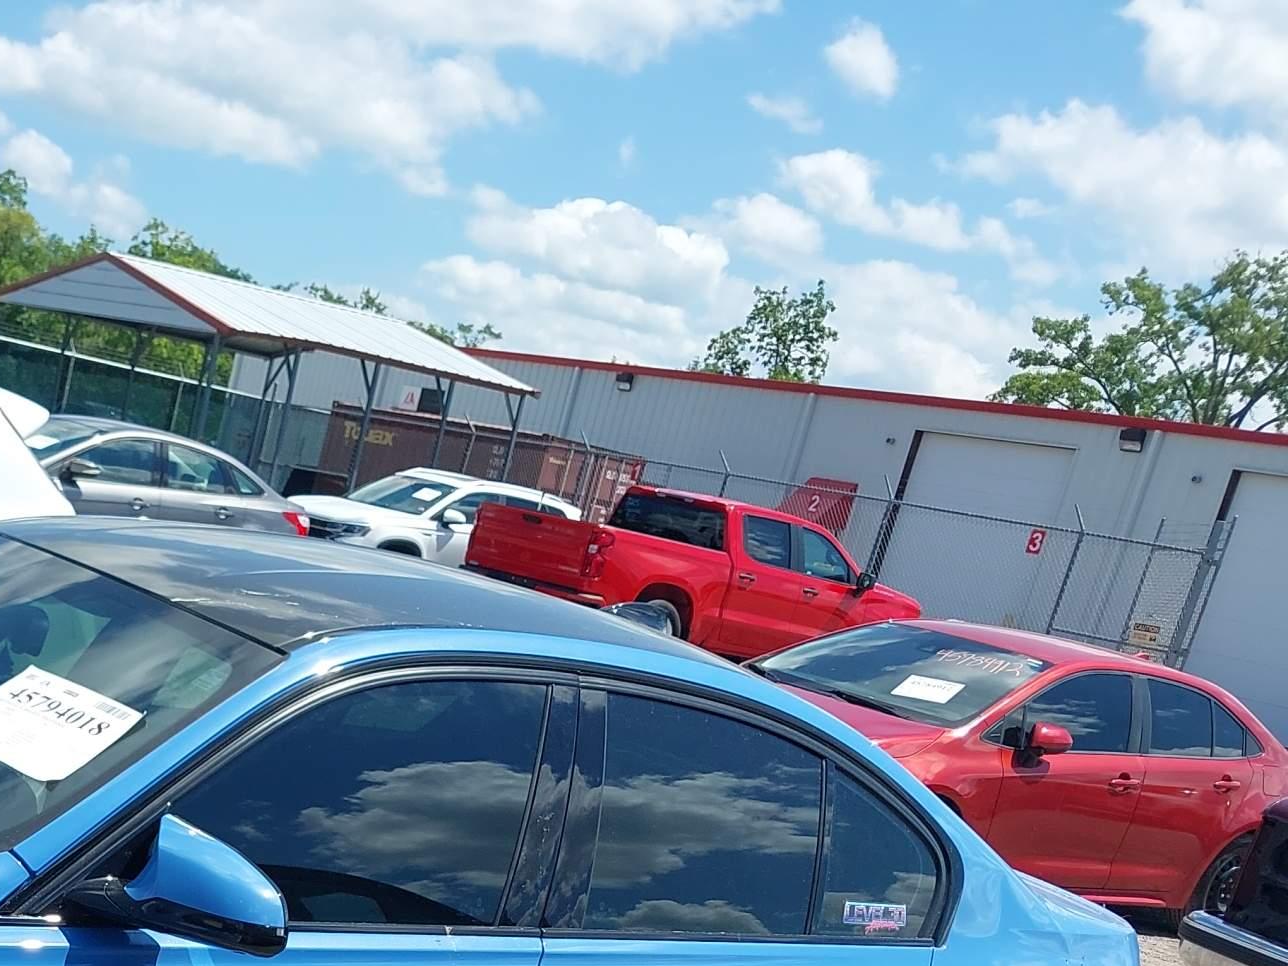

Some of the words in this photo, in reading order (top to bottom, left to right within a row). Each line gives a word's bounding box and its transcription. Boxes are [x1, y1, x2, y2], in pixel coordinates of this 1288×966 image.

[808, 494, 820, 512] 2
[1028, 532, 1043, 552] 3
[1134, 624, 1160, 634] CAUTION
[8, 688, 112, 737] 45794018
